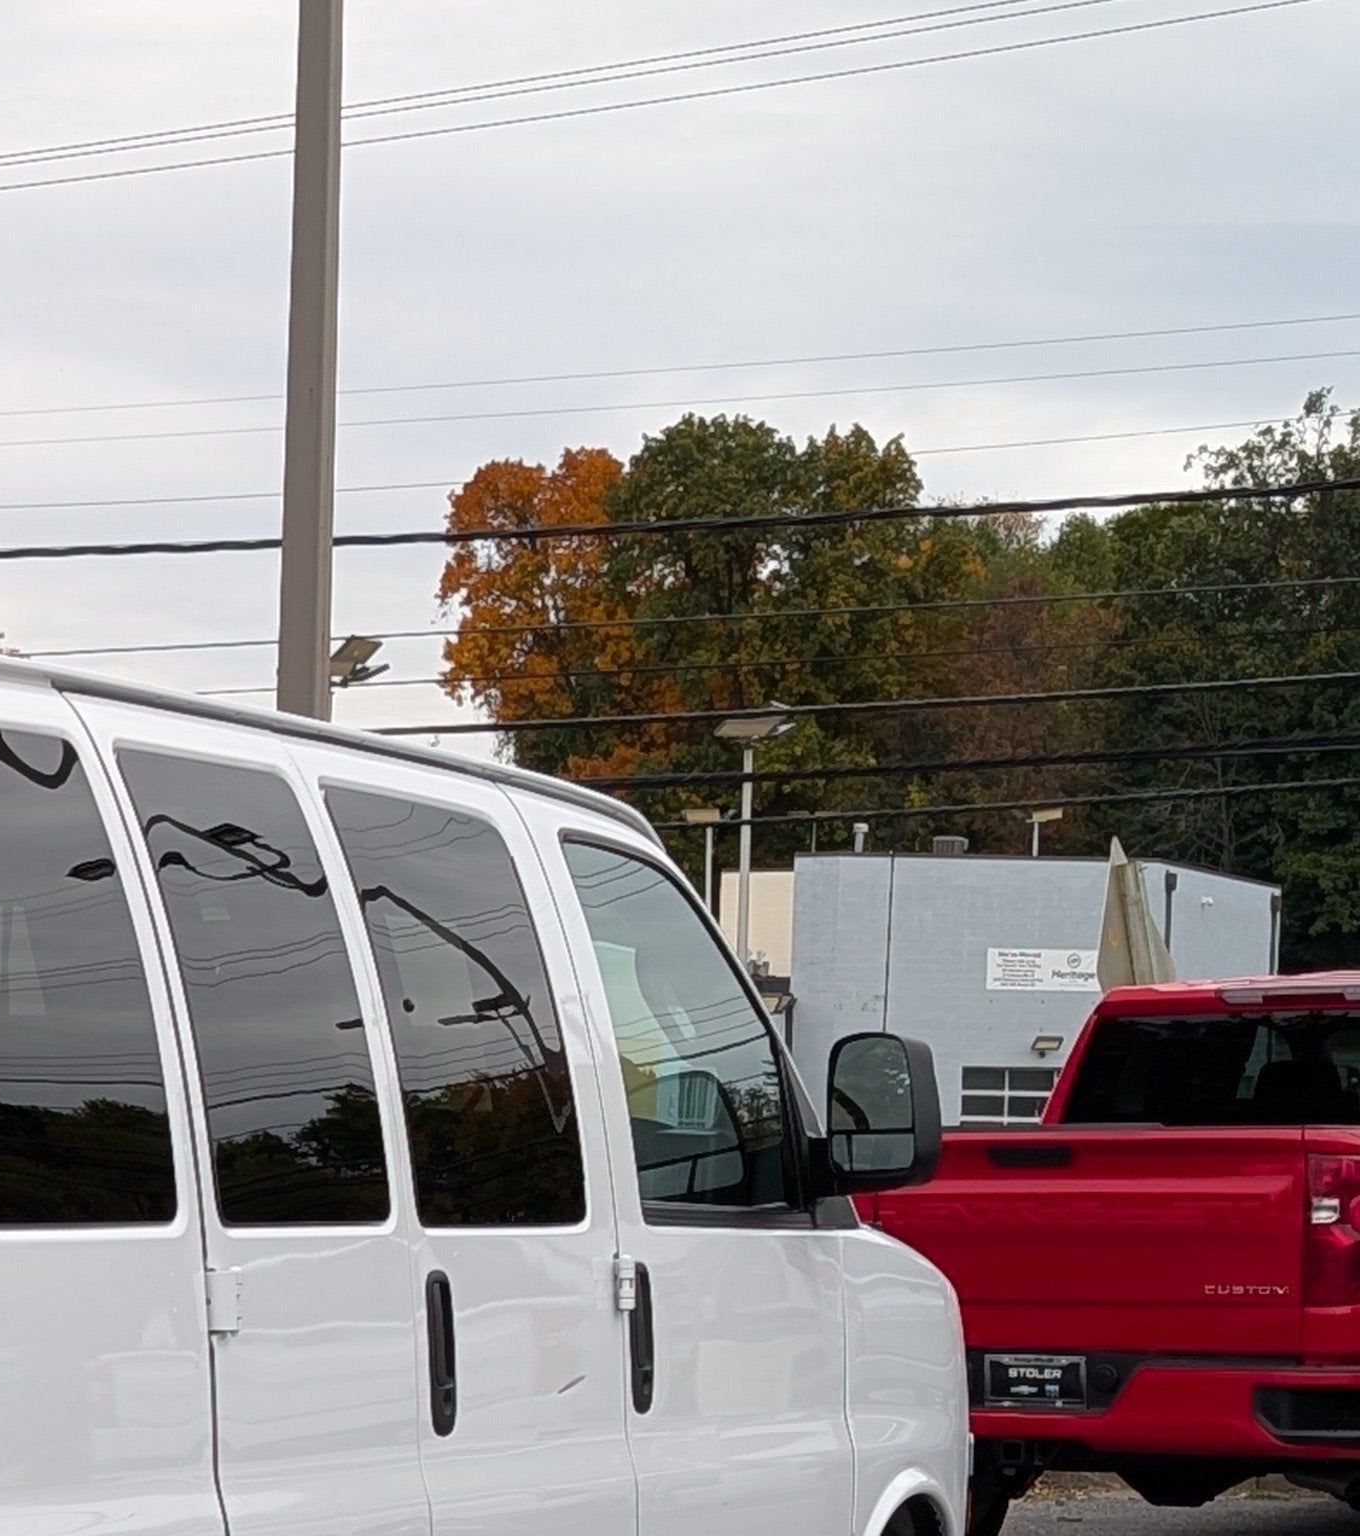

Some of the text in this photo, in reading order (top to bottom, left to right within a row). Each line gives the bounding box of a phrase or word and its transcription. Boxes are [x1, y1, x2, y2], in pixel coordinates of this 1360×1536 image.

[1051, 970, 1096, 982] Heritage
[1204, 1284, 1290, 1295] CUSTOM
[1007, 1367, 1062, 1379] STOLER
